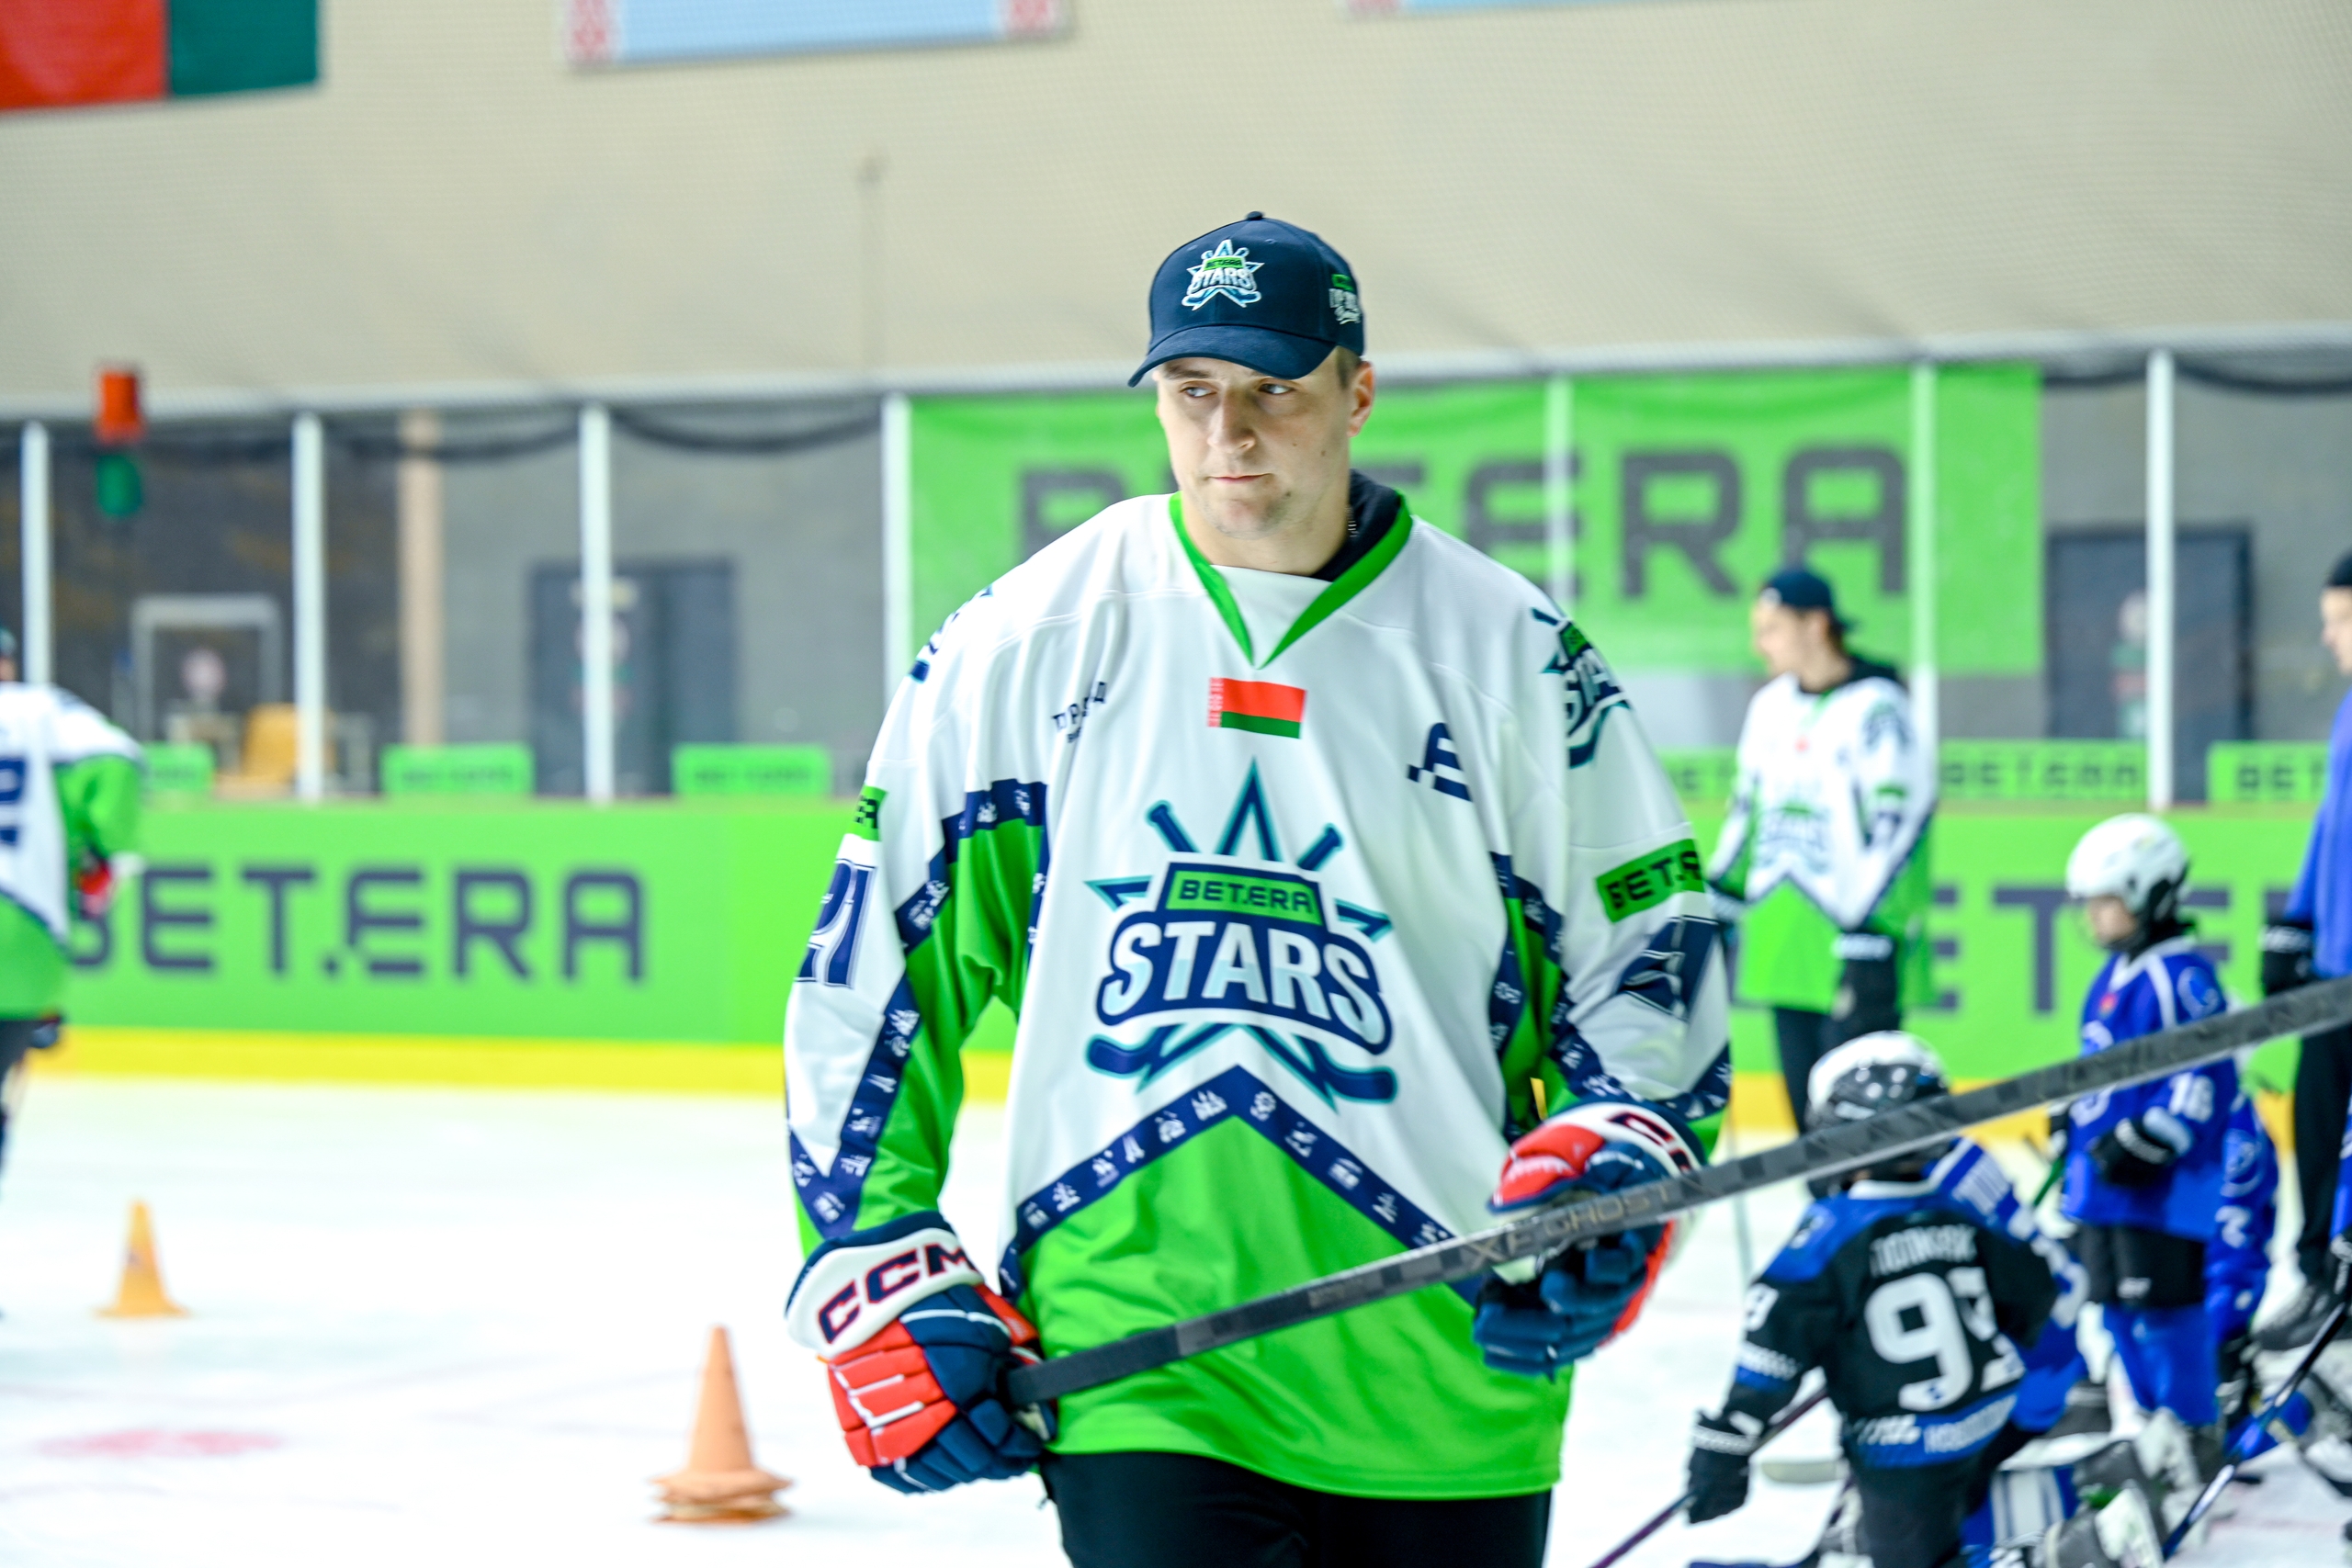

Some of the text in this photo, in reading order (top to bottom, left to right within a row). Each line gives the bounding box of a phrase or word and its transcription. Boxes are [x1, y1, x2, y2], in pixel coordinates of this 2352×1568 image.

[1189, 266, 1253, 292] STARS
[1178, 878, 1315, 915] BET.ERA
[1102, 919, 1386, 1045] STARS
[818, 1243, 978, 1345] CCM
